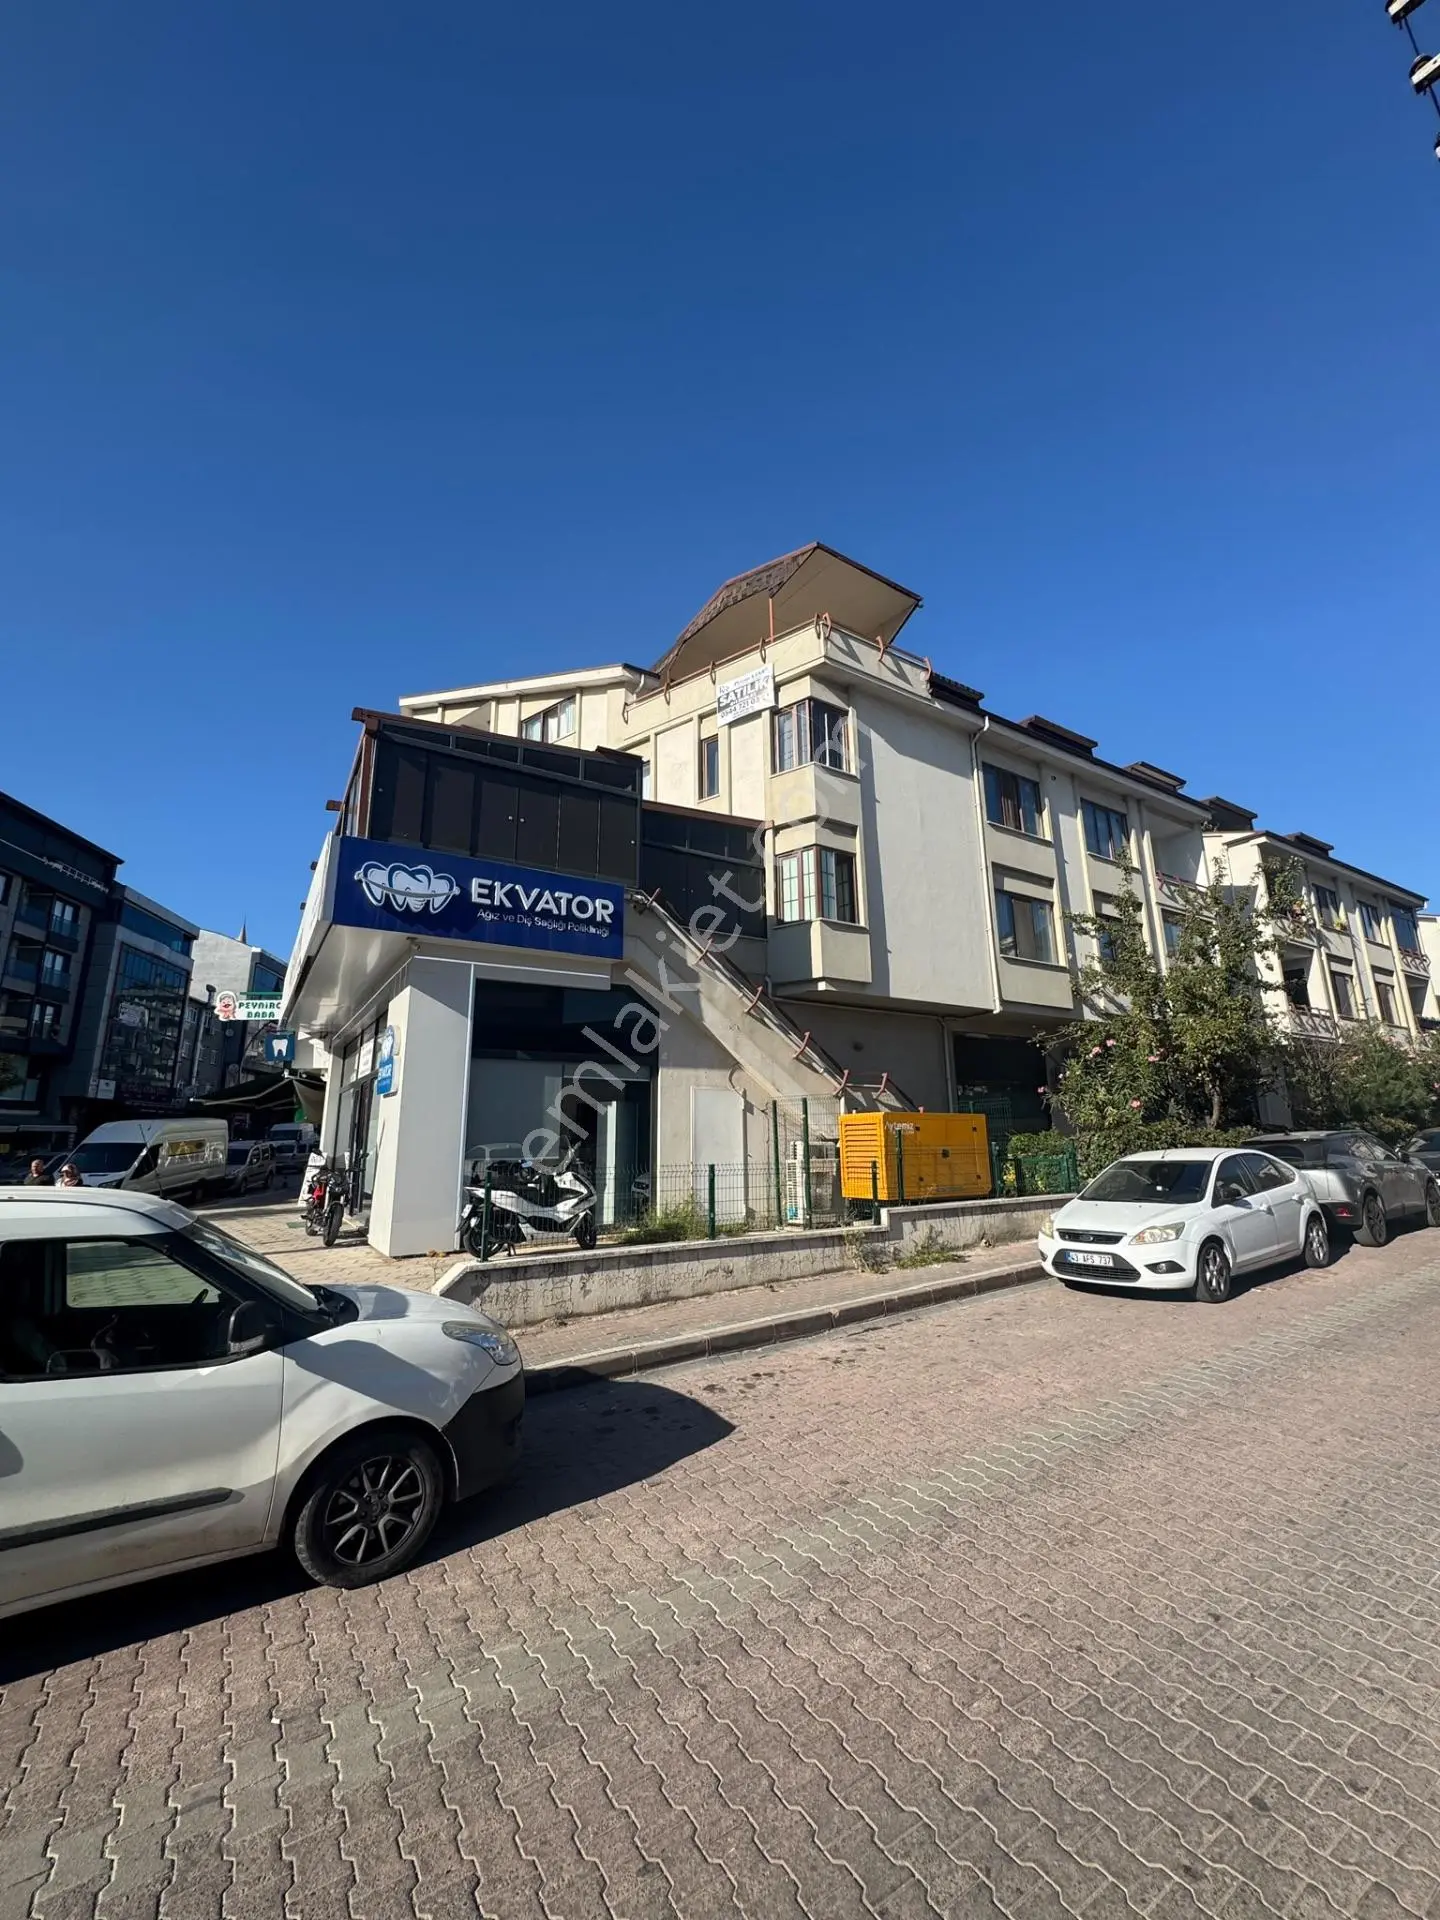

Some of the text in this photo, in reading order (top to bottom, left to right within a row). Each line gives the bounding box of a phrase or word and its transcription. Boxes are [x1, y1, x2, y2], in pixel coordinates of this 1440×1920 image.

[471, 877, 615, 924] EKVATOR
[477, 908, 500, 921] Ağız
[502, 914, 515, 923] ve
[516, 914, 533, 927] Diş
[238, 1001, 281, 1009] PEYNİRC
